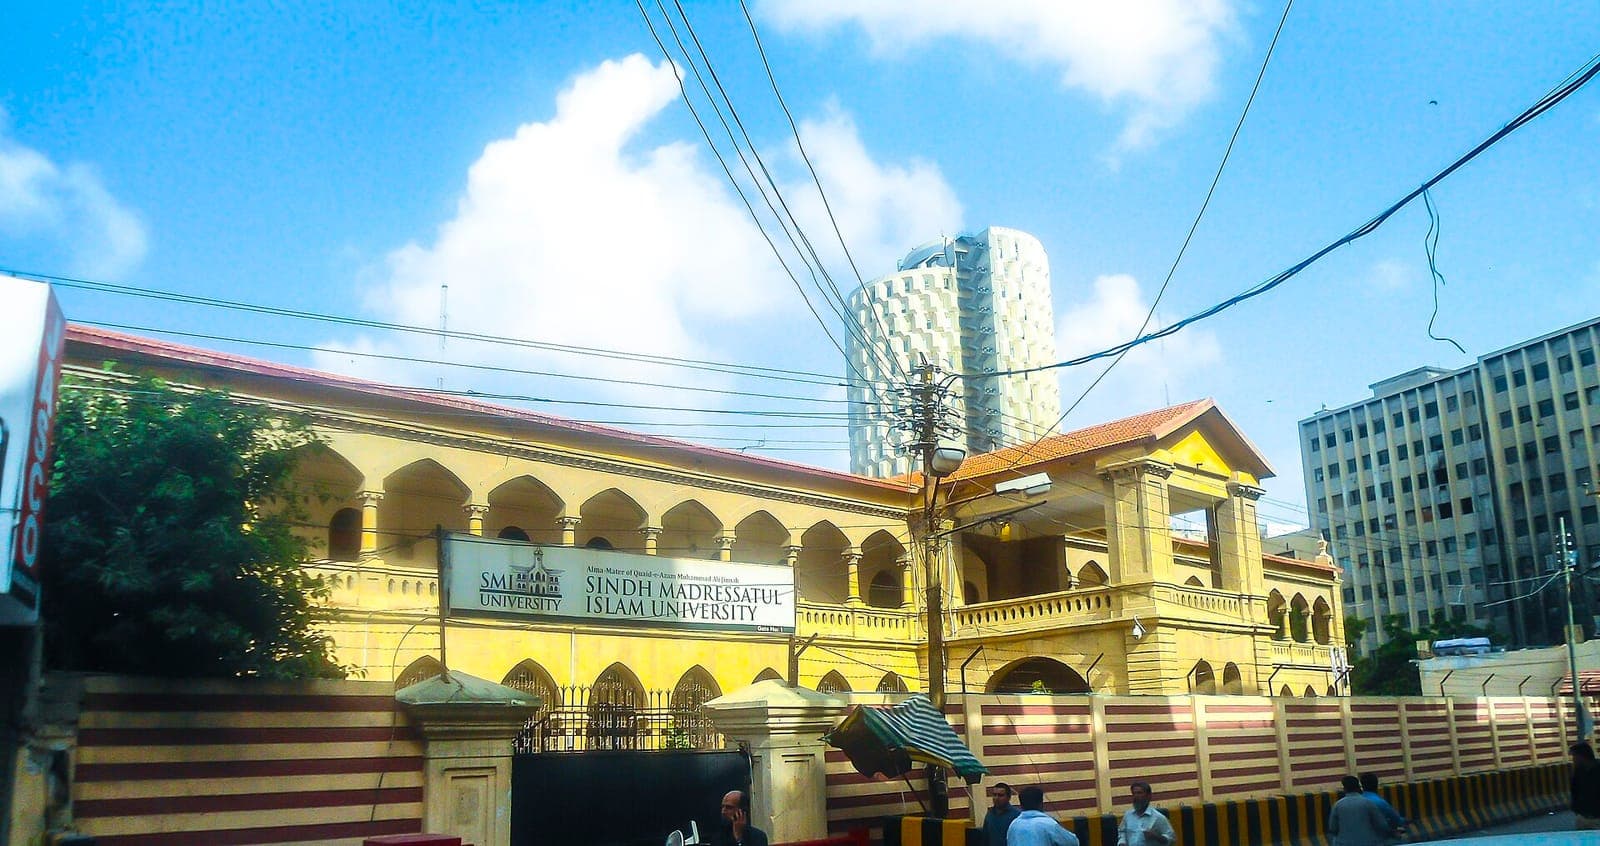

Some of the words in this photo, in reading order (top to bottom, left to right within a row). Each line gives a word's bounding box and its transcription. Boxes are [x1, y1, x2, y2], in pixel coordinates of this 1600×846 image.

[480, 571, 513, 590] SMI
[587, 565, 625, 576] Alma-Mater
[634, 570, 676, 580] Quaid-e-Azam
[677, 573, 712, 583] Muhammad
[586, 575, 652, 597] SINDH
[659, 582, 782, 605] MADRESSATUL
[480, 593, 561, 611] UNIVERSITY
[586, 595, 645, 616] ISLAM
[651, 600, 757, 621] UNIVERSITY
